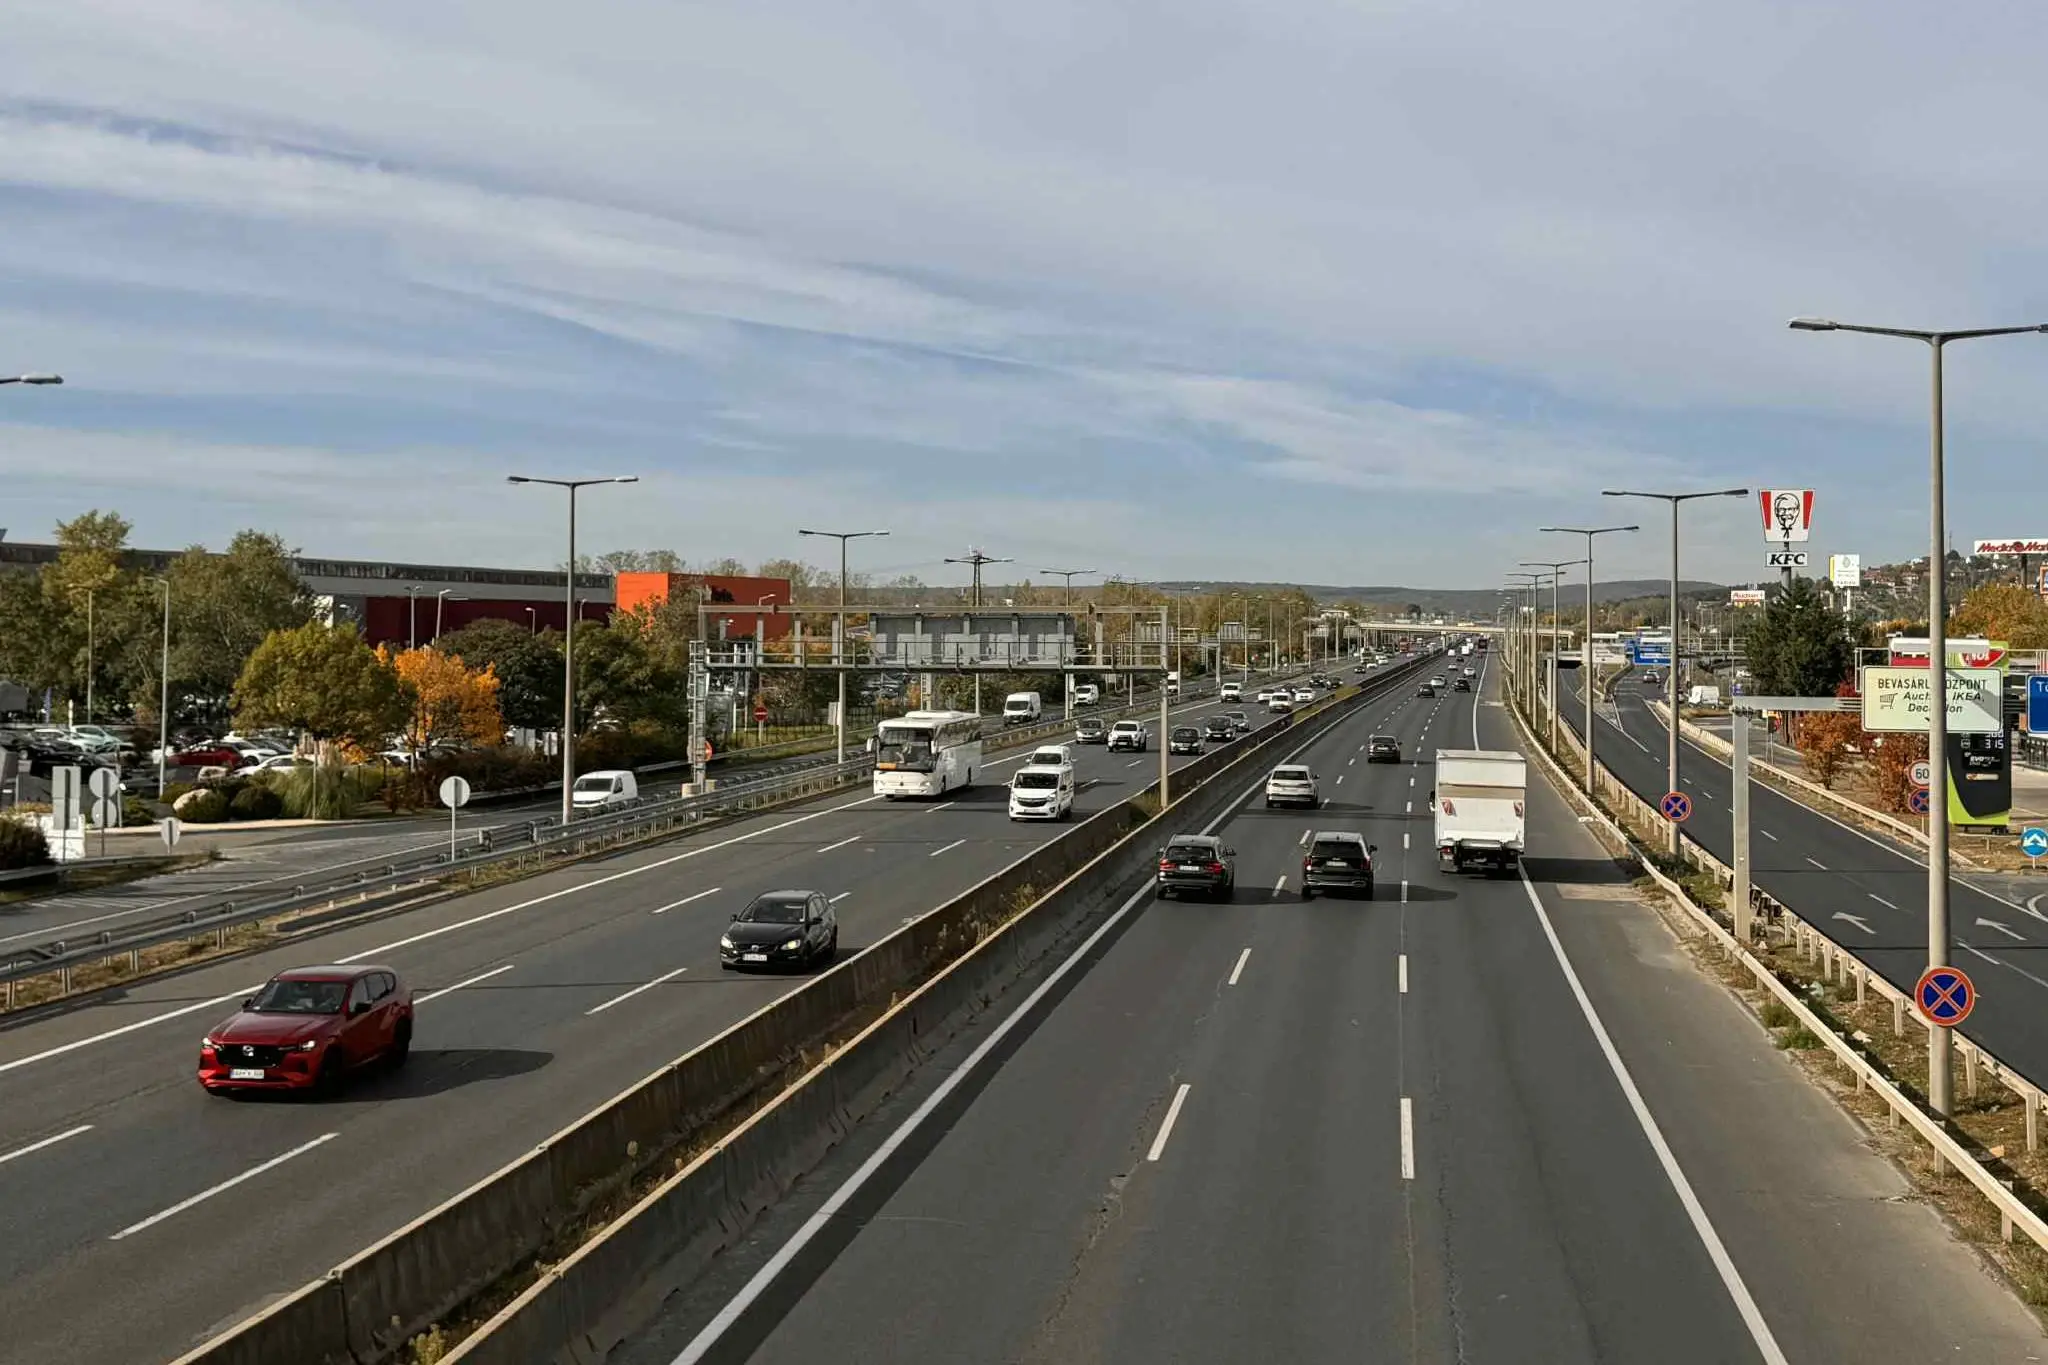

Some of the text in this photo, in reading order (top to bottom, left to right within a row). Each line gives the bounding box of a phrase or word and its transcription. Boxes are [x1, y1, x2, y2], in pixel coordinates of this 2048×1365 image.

[1769, 553, 1806, 565] KFC
[1907, 703, 1963, 713] Declon
[1915, 768, 1930, 779] 60
